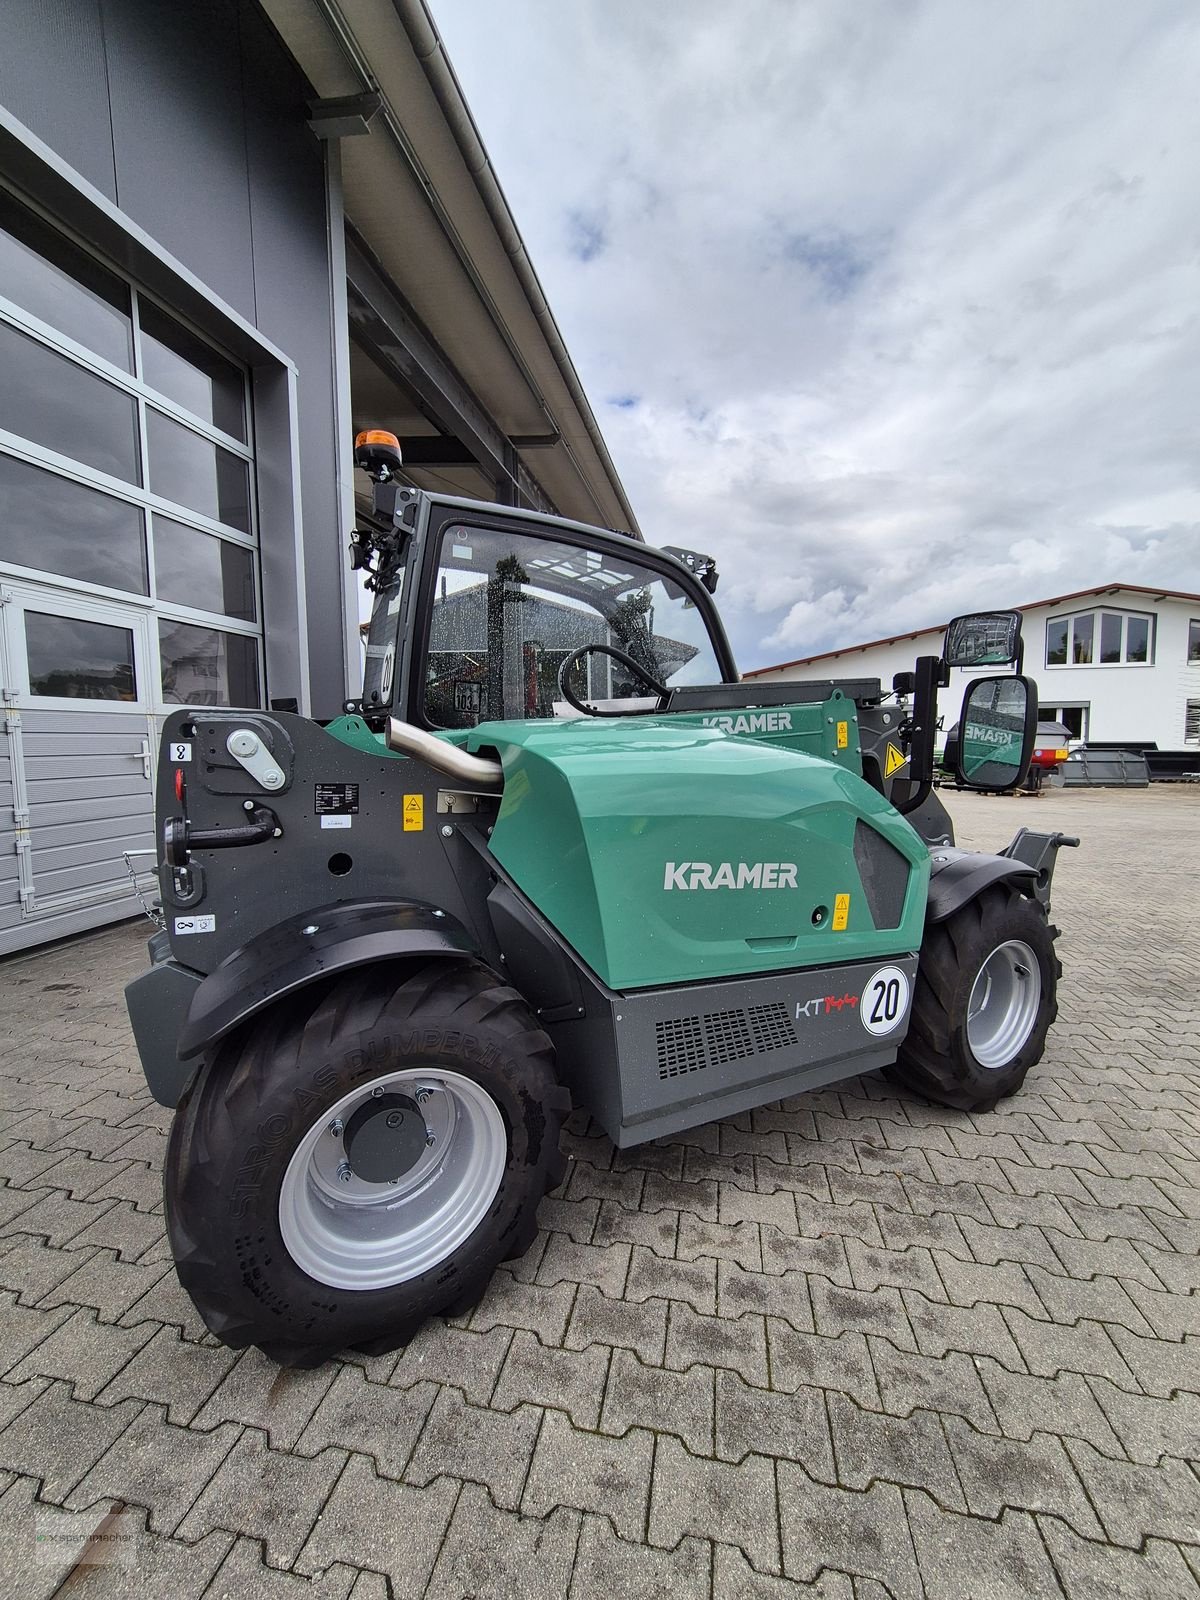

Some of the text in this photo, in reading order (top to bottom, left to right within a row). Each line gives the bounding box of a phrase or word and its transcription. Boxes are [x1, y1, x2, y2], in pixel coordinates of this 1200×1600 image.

[663, 862, 798, 890] KRAMER
[869, 978, 900, 1023] 20
[344, 1029, 479, 1072] DUMPER
